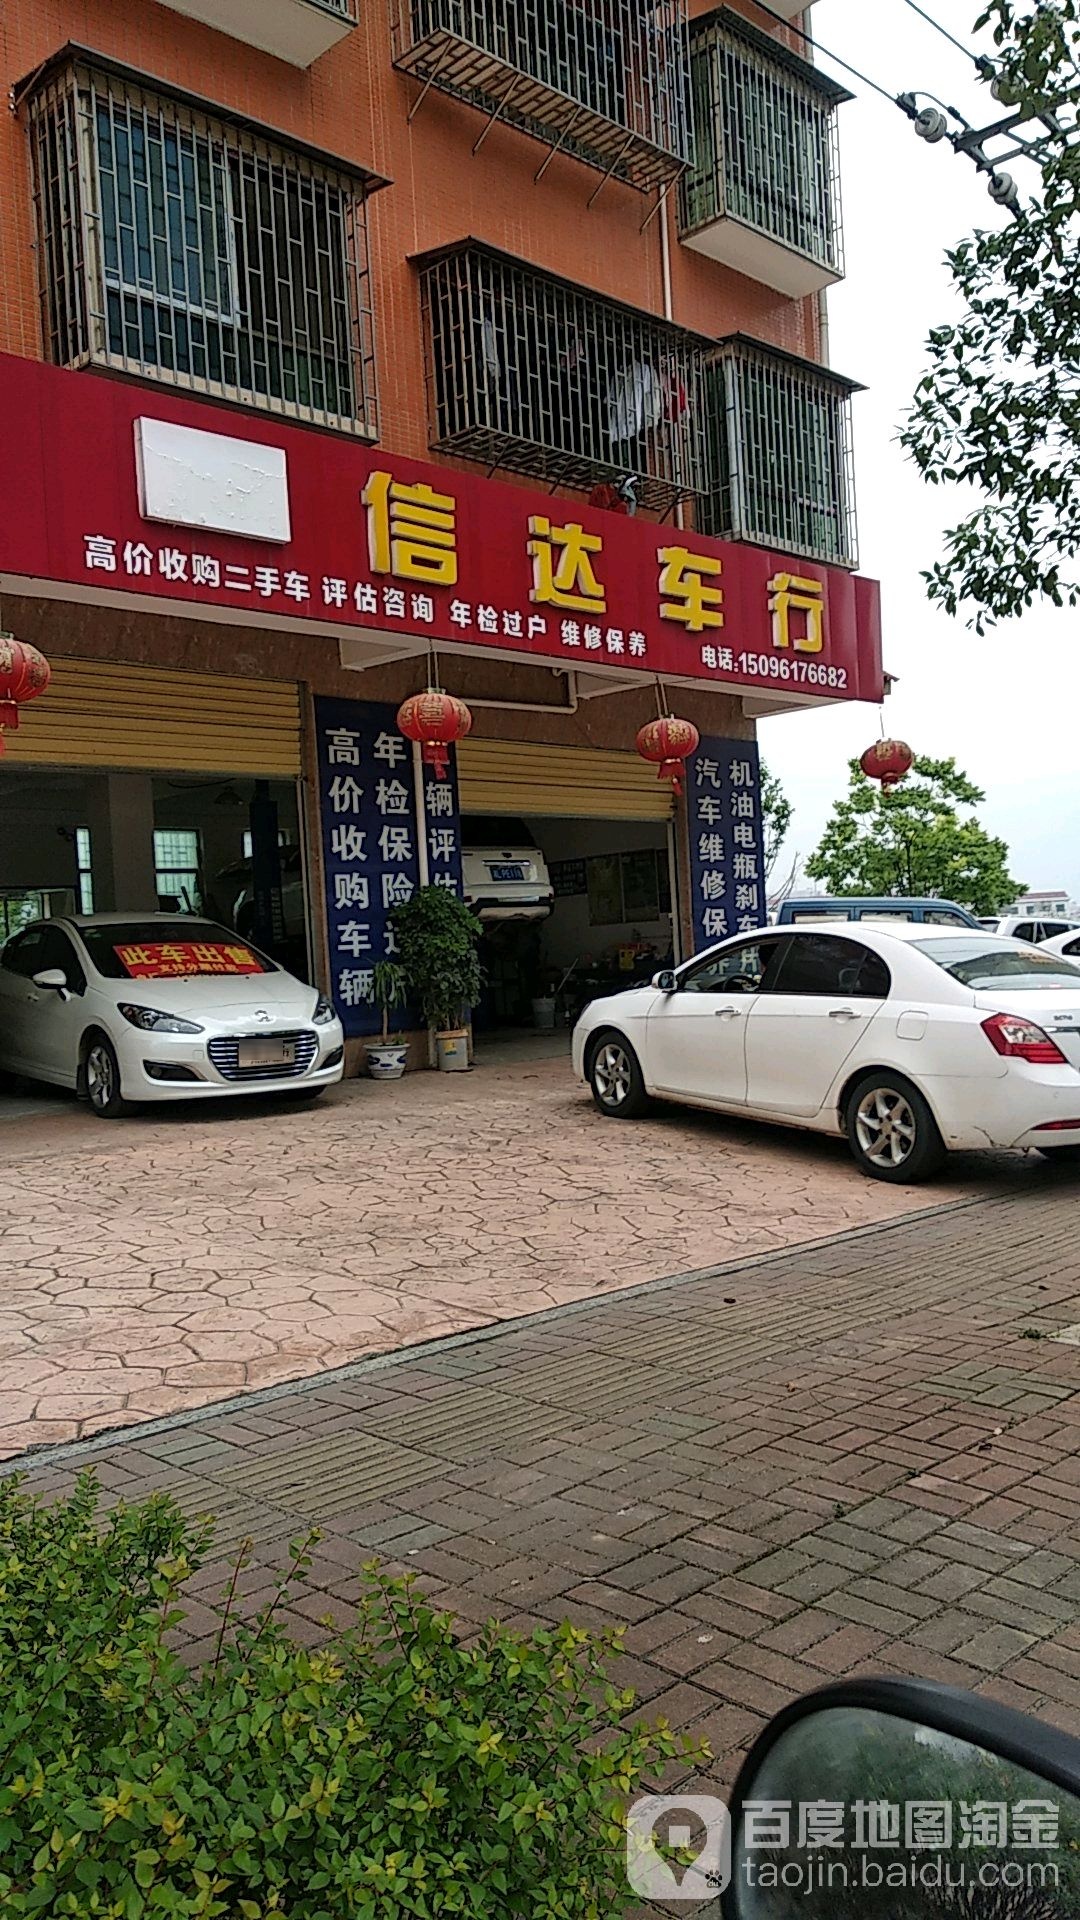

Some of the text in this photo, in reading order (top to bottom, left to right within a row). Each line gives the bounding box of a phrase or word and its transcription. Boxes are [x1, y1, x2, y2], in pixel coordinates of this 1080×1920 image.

[83, 534, 647, 657] 高价收购二手车 评估咨询 年检过户 维修保养
[359, 470, 825, 654] 信达车行
[701, 643, 848, 690] 电话:15096176682
[325, 727, 375, 1007] 高价收购车辆
[373, 731, 416, 1003] 年检保险
[121, 944, 256, 966] 此车出售
